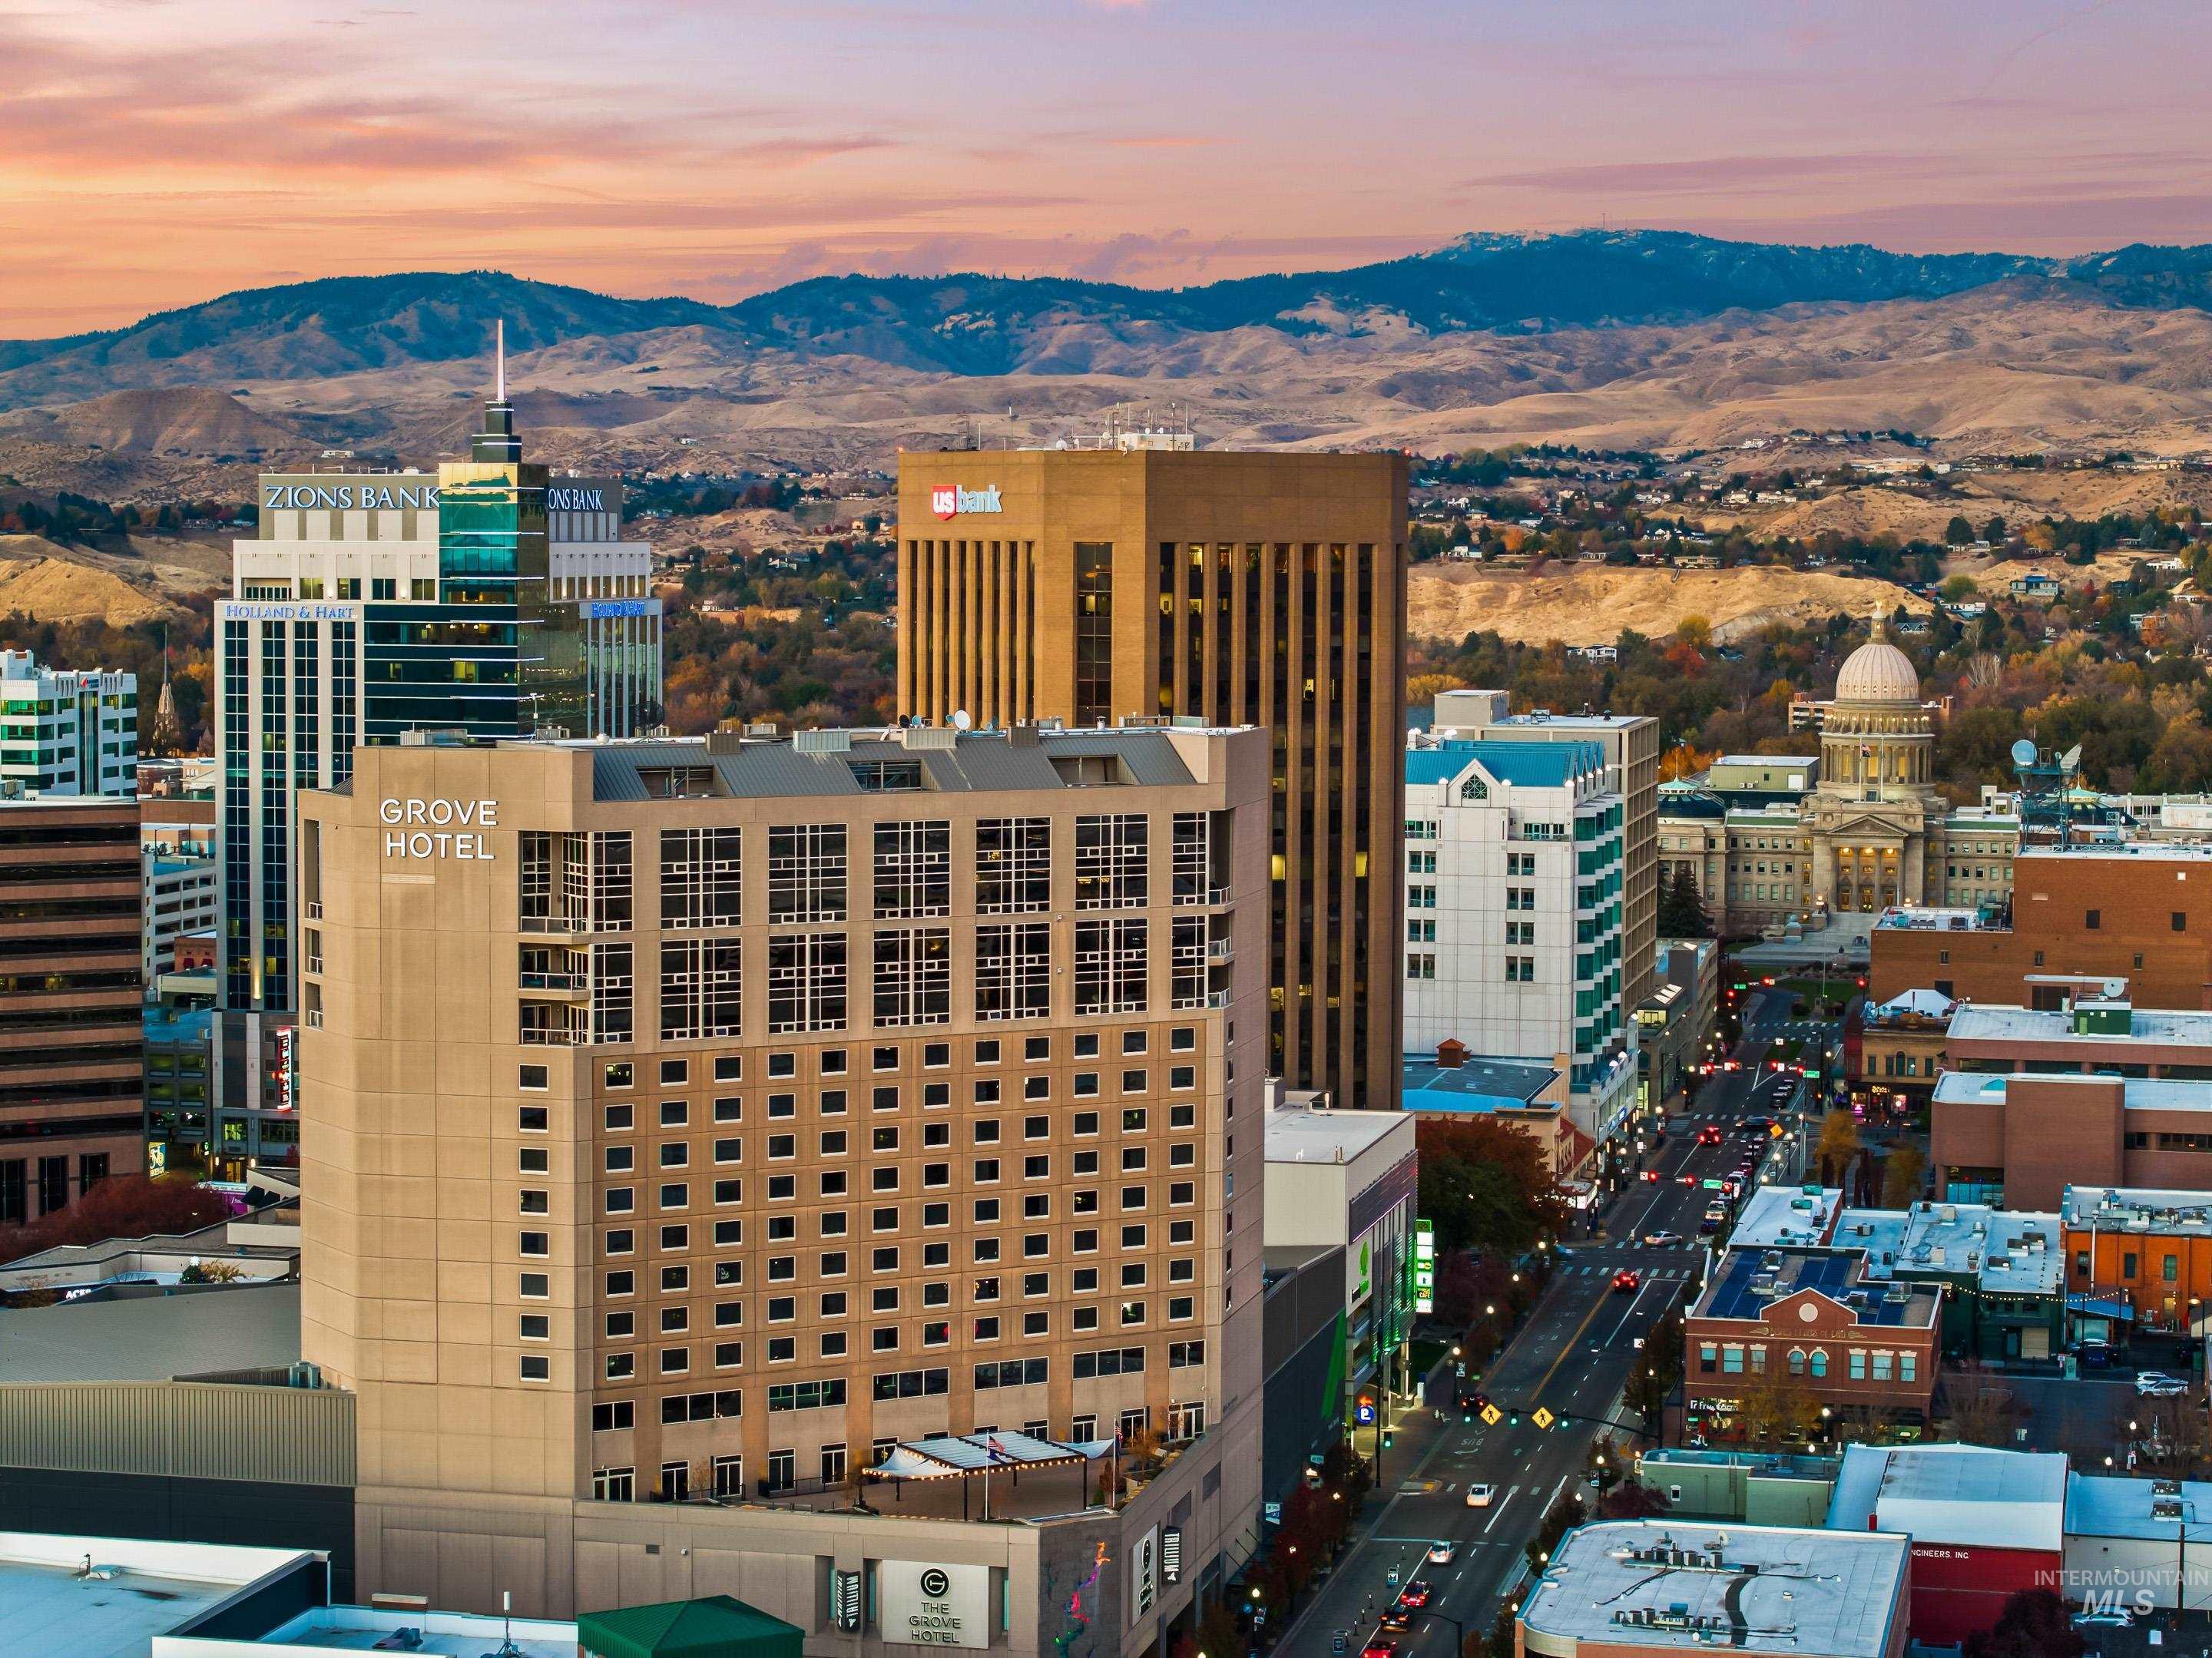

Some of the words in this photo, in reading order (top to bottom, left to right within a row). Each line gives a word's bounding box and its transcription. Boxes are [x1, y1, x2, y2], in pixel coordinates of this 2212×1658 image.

[265, 485, 353, 509] ZIONS
[359, 486, 440, 509] BANK
[572, 489, 603, 511] BANK
[227, 604, 295, 619] HOLLAND
[299, 605, 310, 619] &
[316, 606, 355, 619] HART
[380, 799, 498, 826] GROVE
[386, 832, 495, 859] HOTEL
[1164, 1533, 1180, 1573] TRILLIUM
[846, 1575, 859, 1619] TRILLIUM
[921, 1602, 949, 1614] THE
[909, 1615, 961, 1629] GROVE
[912, 1630, 960, 1643] HOTEL
